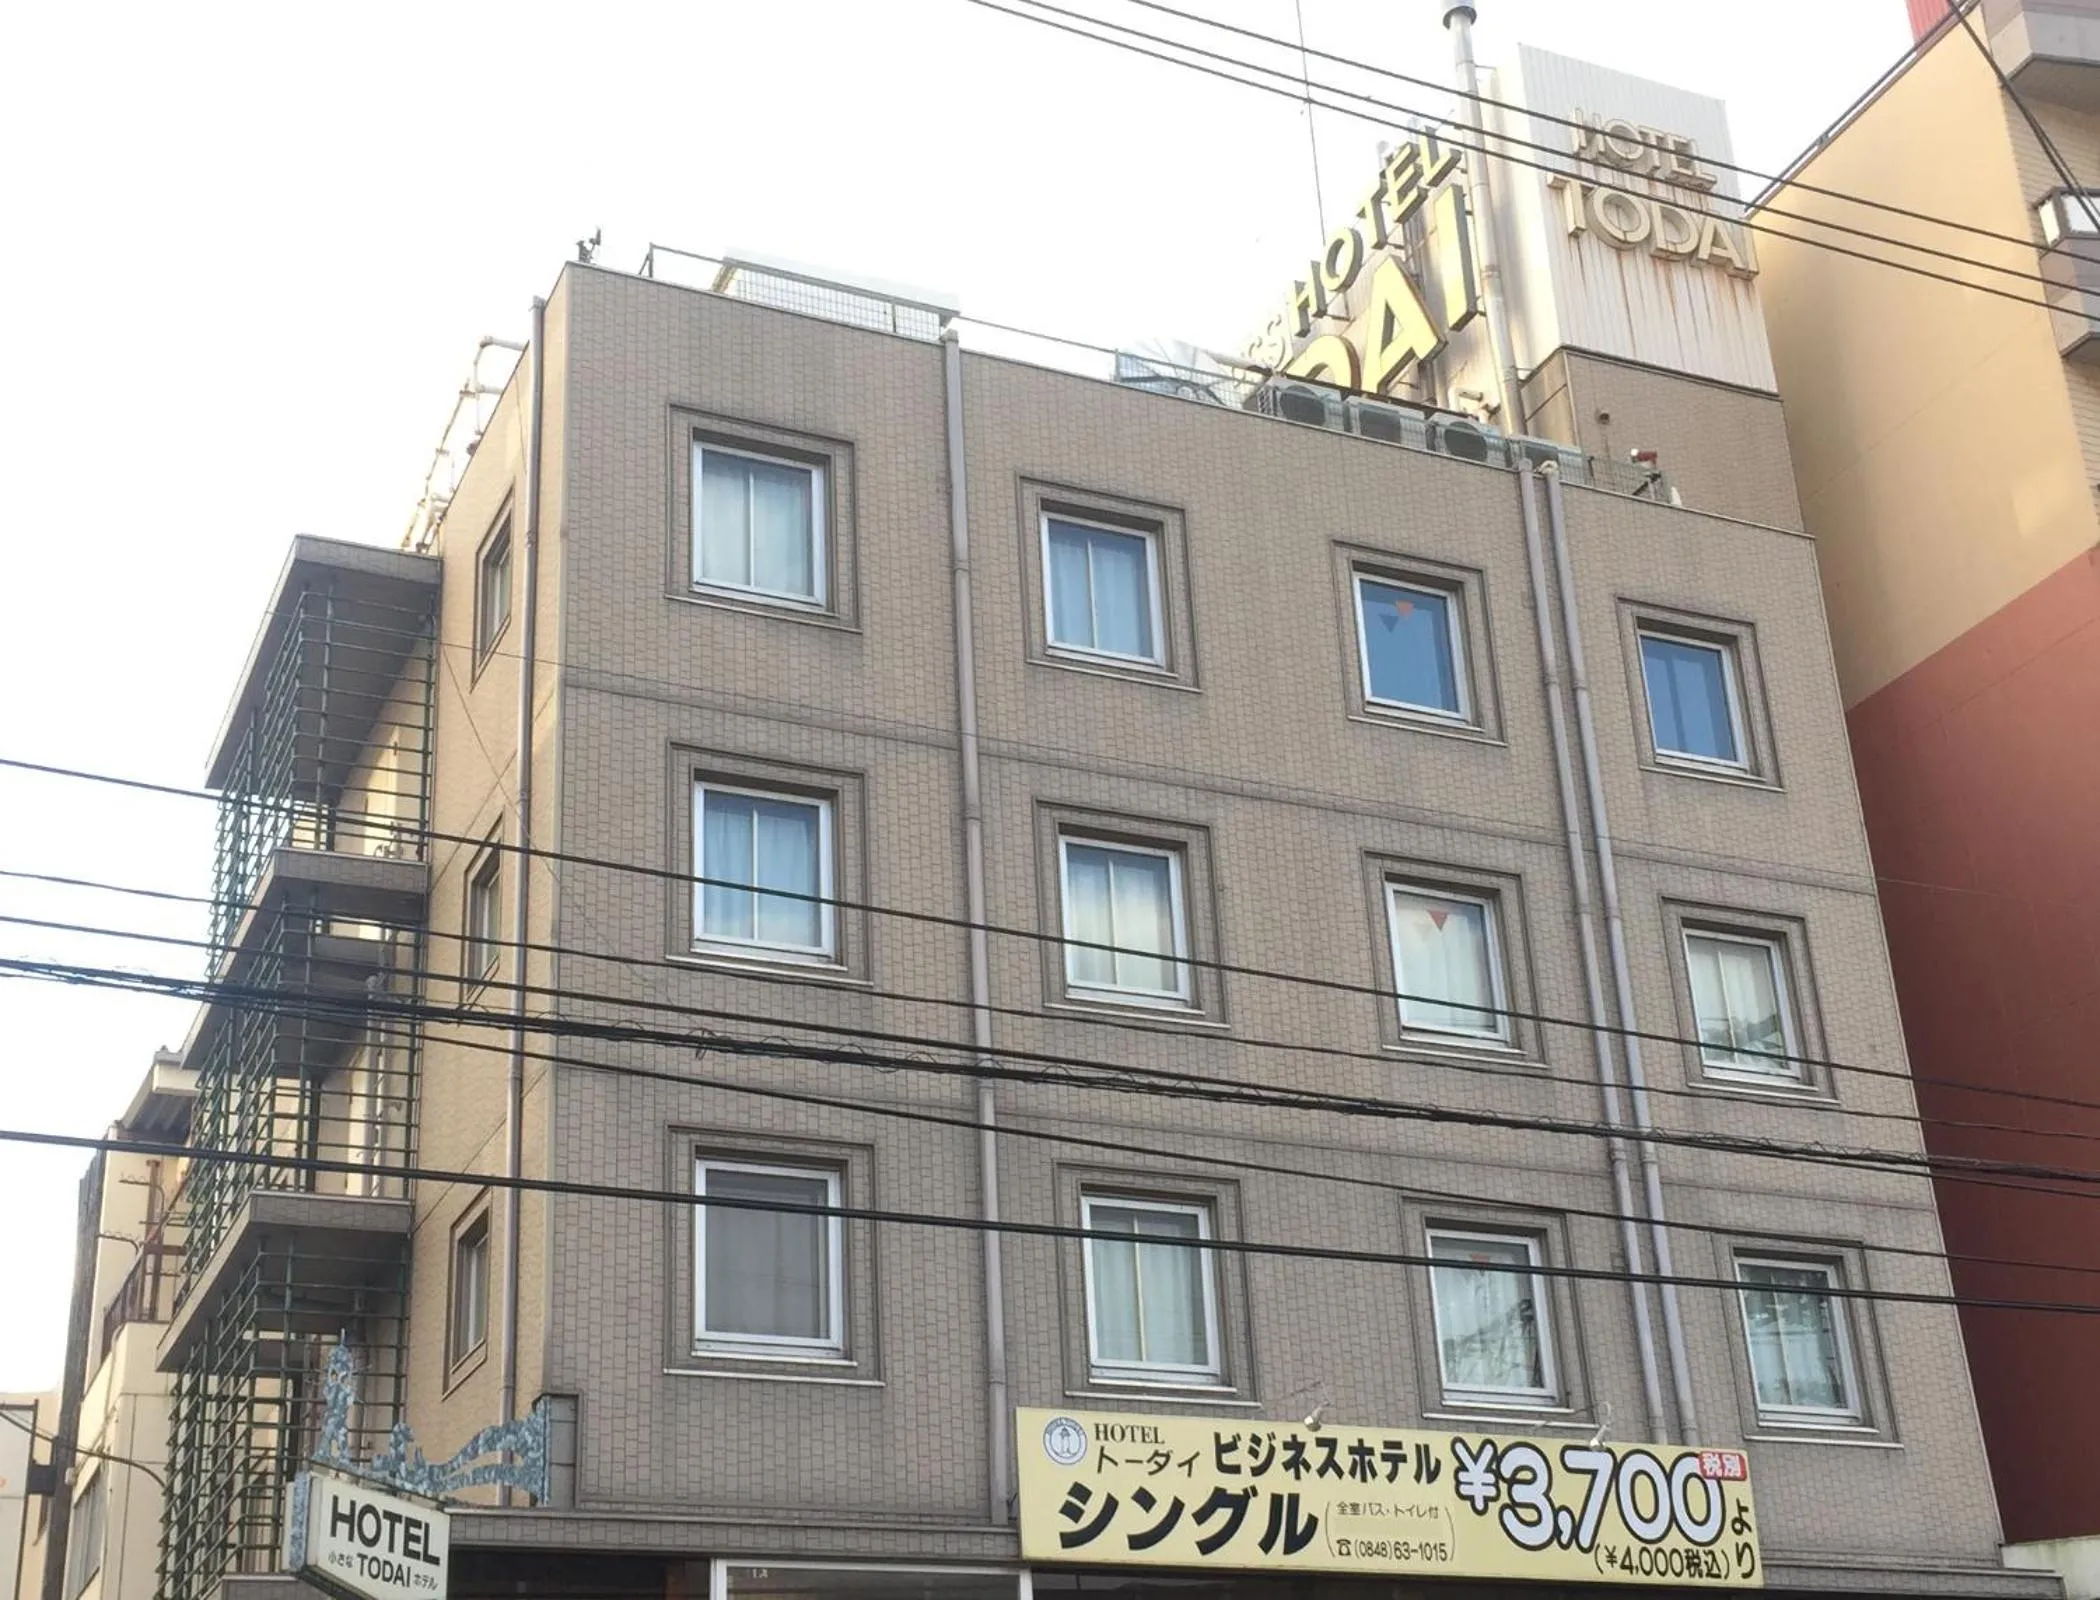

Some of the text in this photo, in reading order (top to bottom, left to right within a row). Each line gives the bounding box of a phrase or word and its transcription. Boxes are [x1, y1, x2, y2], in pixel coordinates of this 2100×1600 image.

[1571, 106, 1718, 190] HOTEL
[1285, 124, 1463, 338] HOTEL
[1094, 1422, 1165, 1444] HOTEL
[1096, 1446, 1200, 1478] トーダイ
[1213, 1432, 1442, 1484] ビジネスホテル
[330, 1494, 441, 1566] HOTEL
[1059, 1481, 1319, 1556] シングル
[1450, 1436, 1726, 1555] ¥3,700
[356, 1552, 412, 1588] TODAI
[413, 1572, 439, 1591] ホテル
[1731, 1498, 1755, 1579] より
